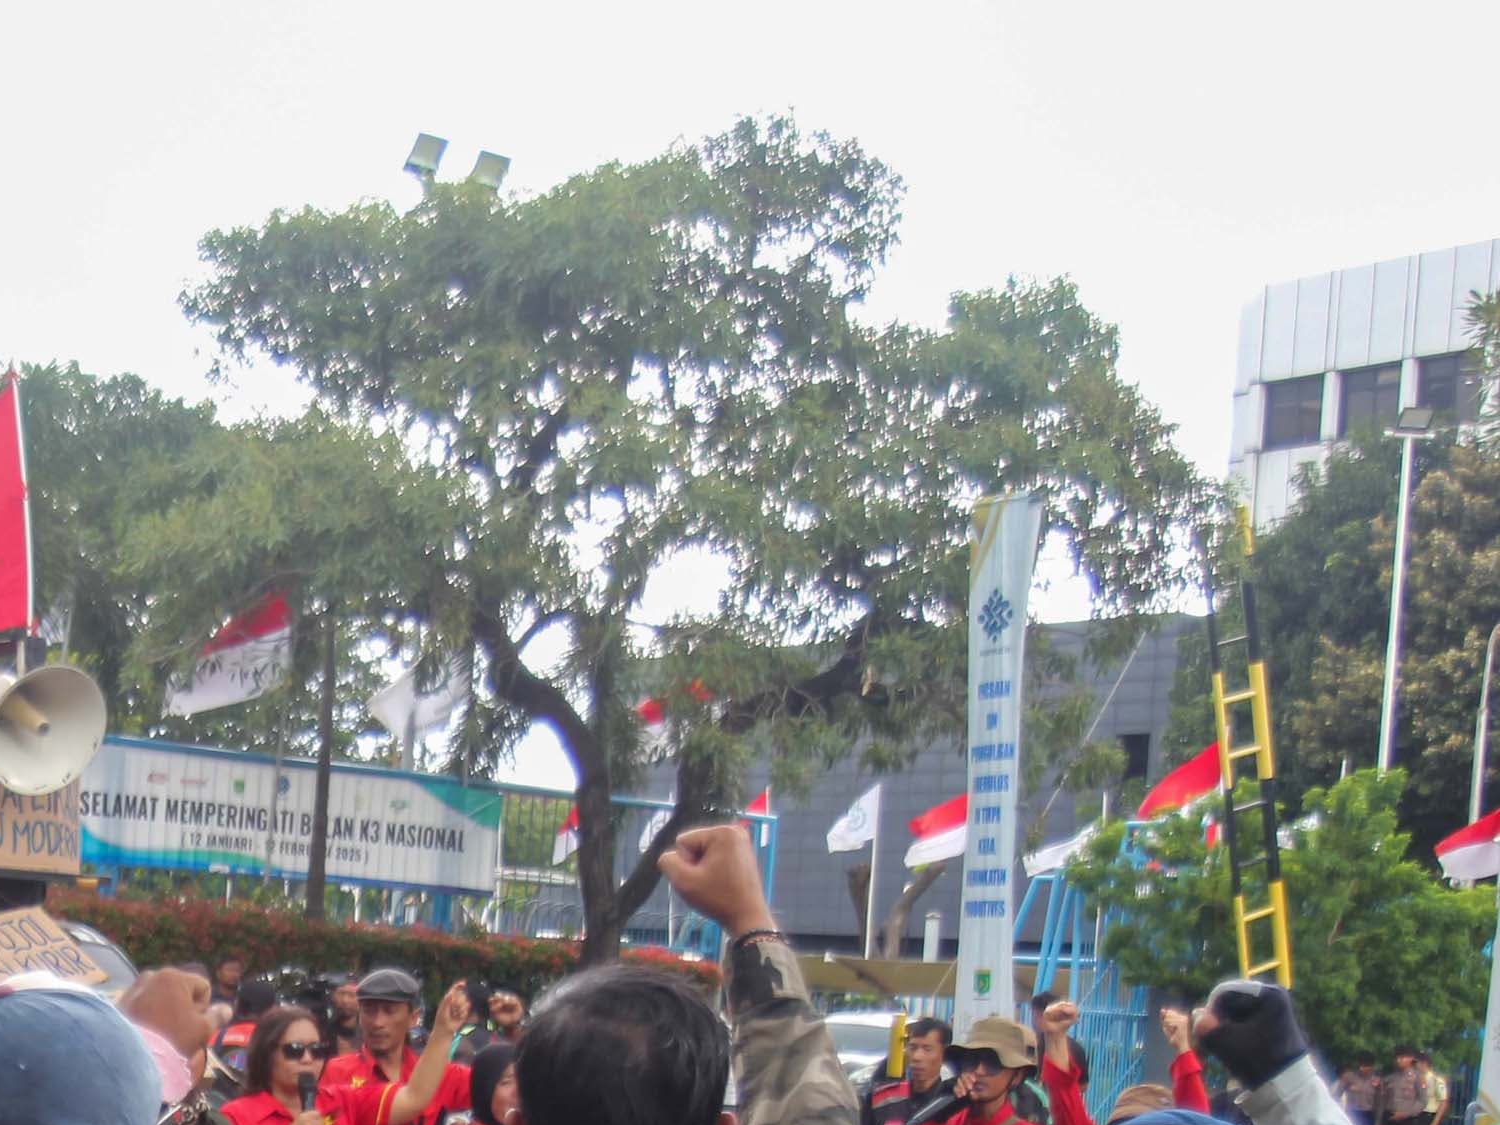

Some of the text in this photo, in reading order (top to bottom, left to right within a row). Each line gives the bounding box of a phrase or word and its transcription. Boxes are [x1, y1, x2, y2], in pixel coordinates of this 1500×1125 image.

[79, 791, 159, 822] SELAMAT
[300, 812, 354, 841] BLAN
[359, 818, 380, 844] K3
[384, 823, 464, 853] NASIONAL
